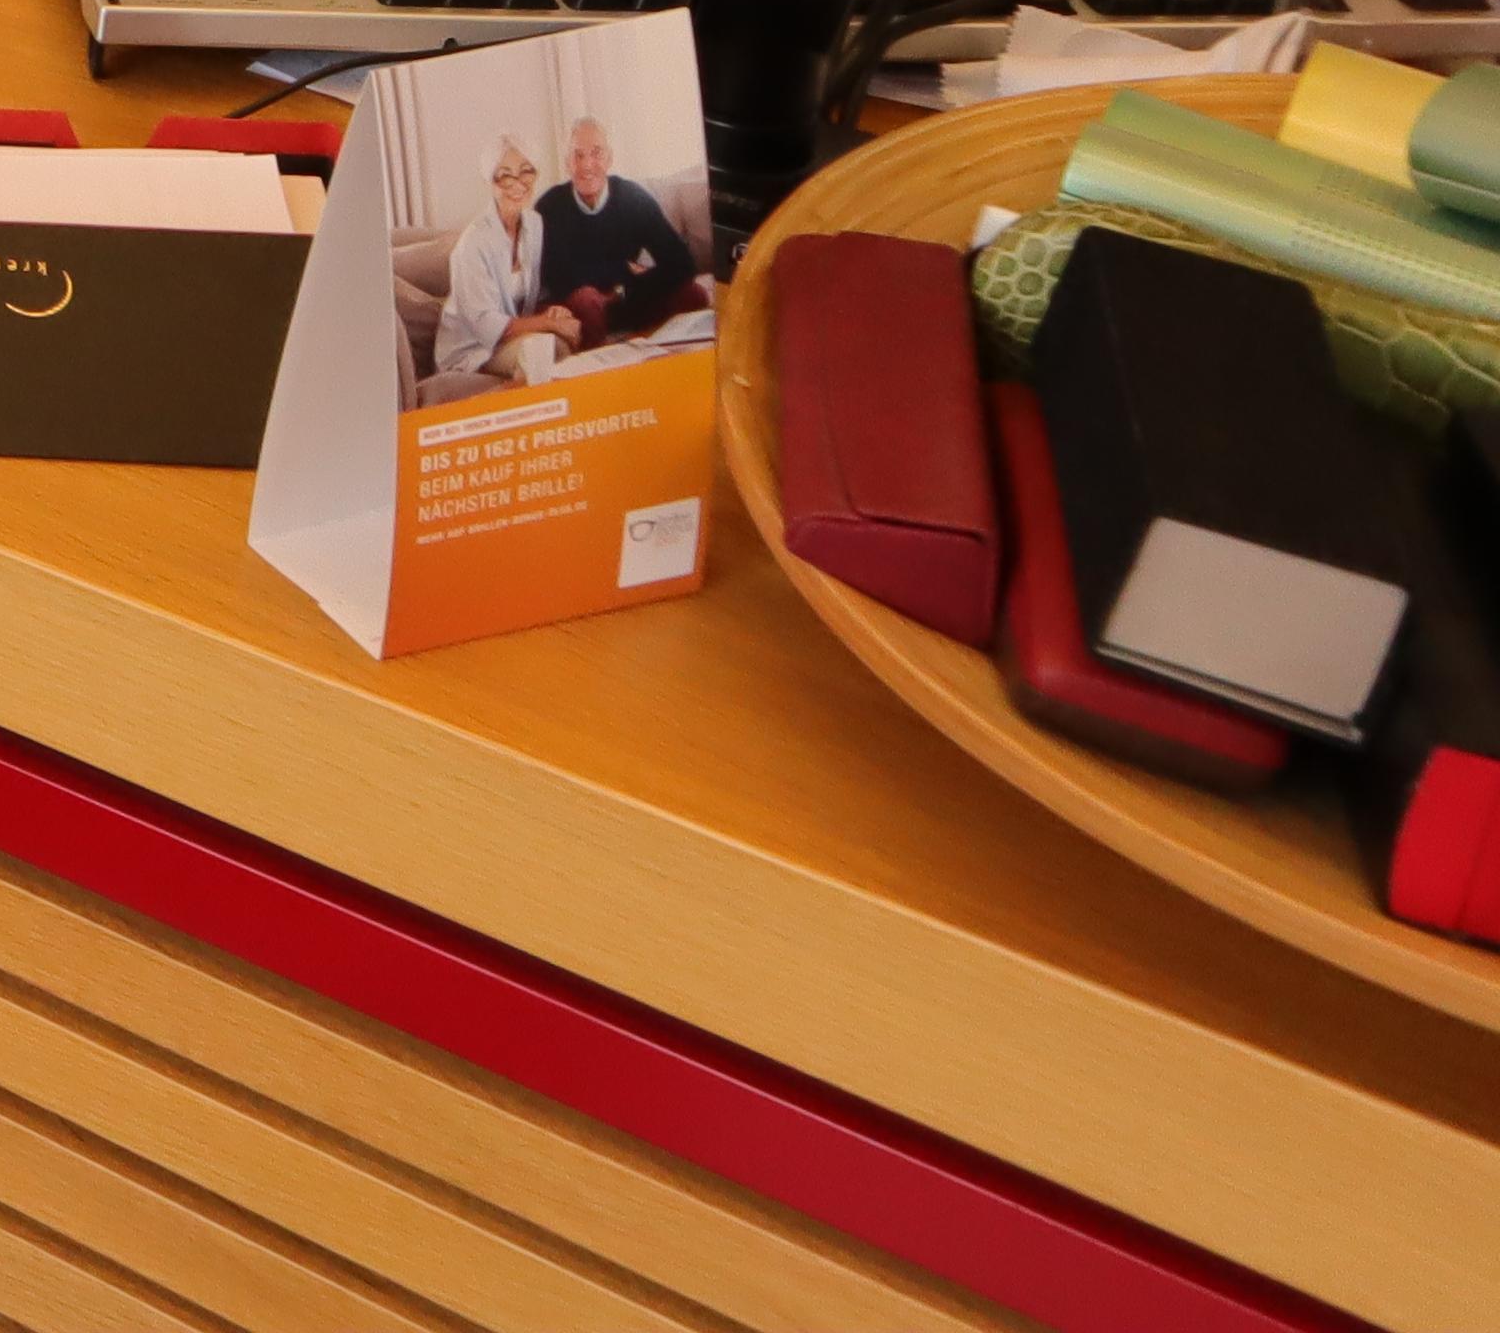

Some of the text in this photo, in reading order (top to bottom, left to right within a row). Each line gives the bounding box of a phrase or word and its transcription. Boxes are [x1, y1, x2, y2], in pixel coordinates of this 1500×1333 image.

[420, 452, 450, 474] BIS
[455, 446, 479, 466] ZU
[532, 407, 658, 450] PREISVORTEIL
[419, 449, 575, 500] BEIM KAUF IHRER
[417, 487, 512, 523] NÄCHSTEN
